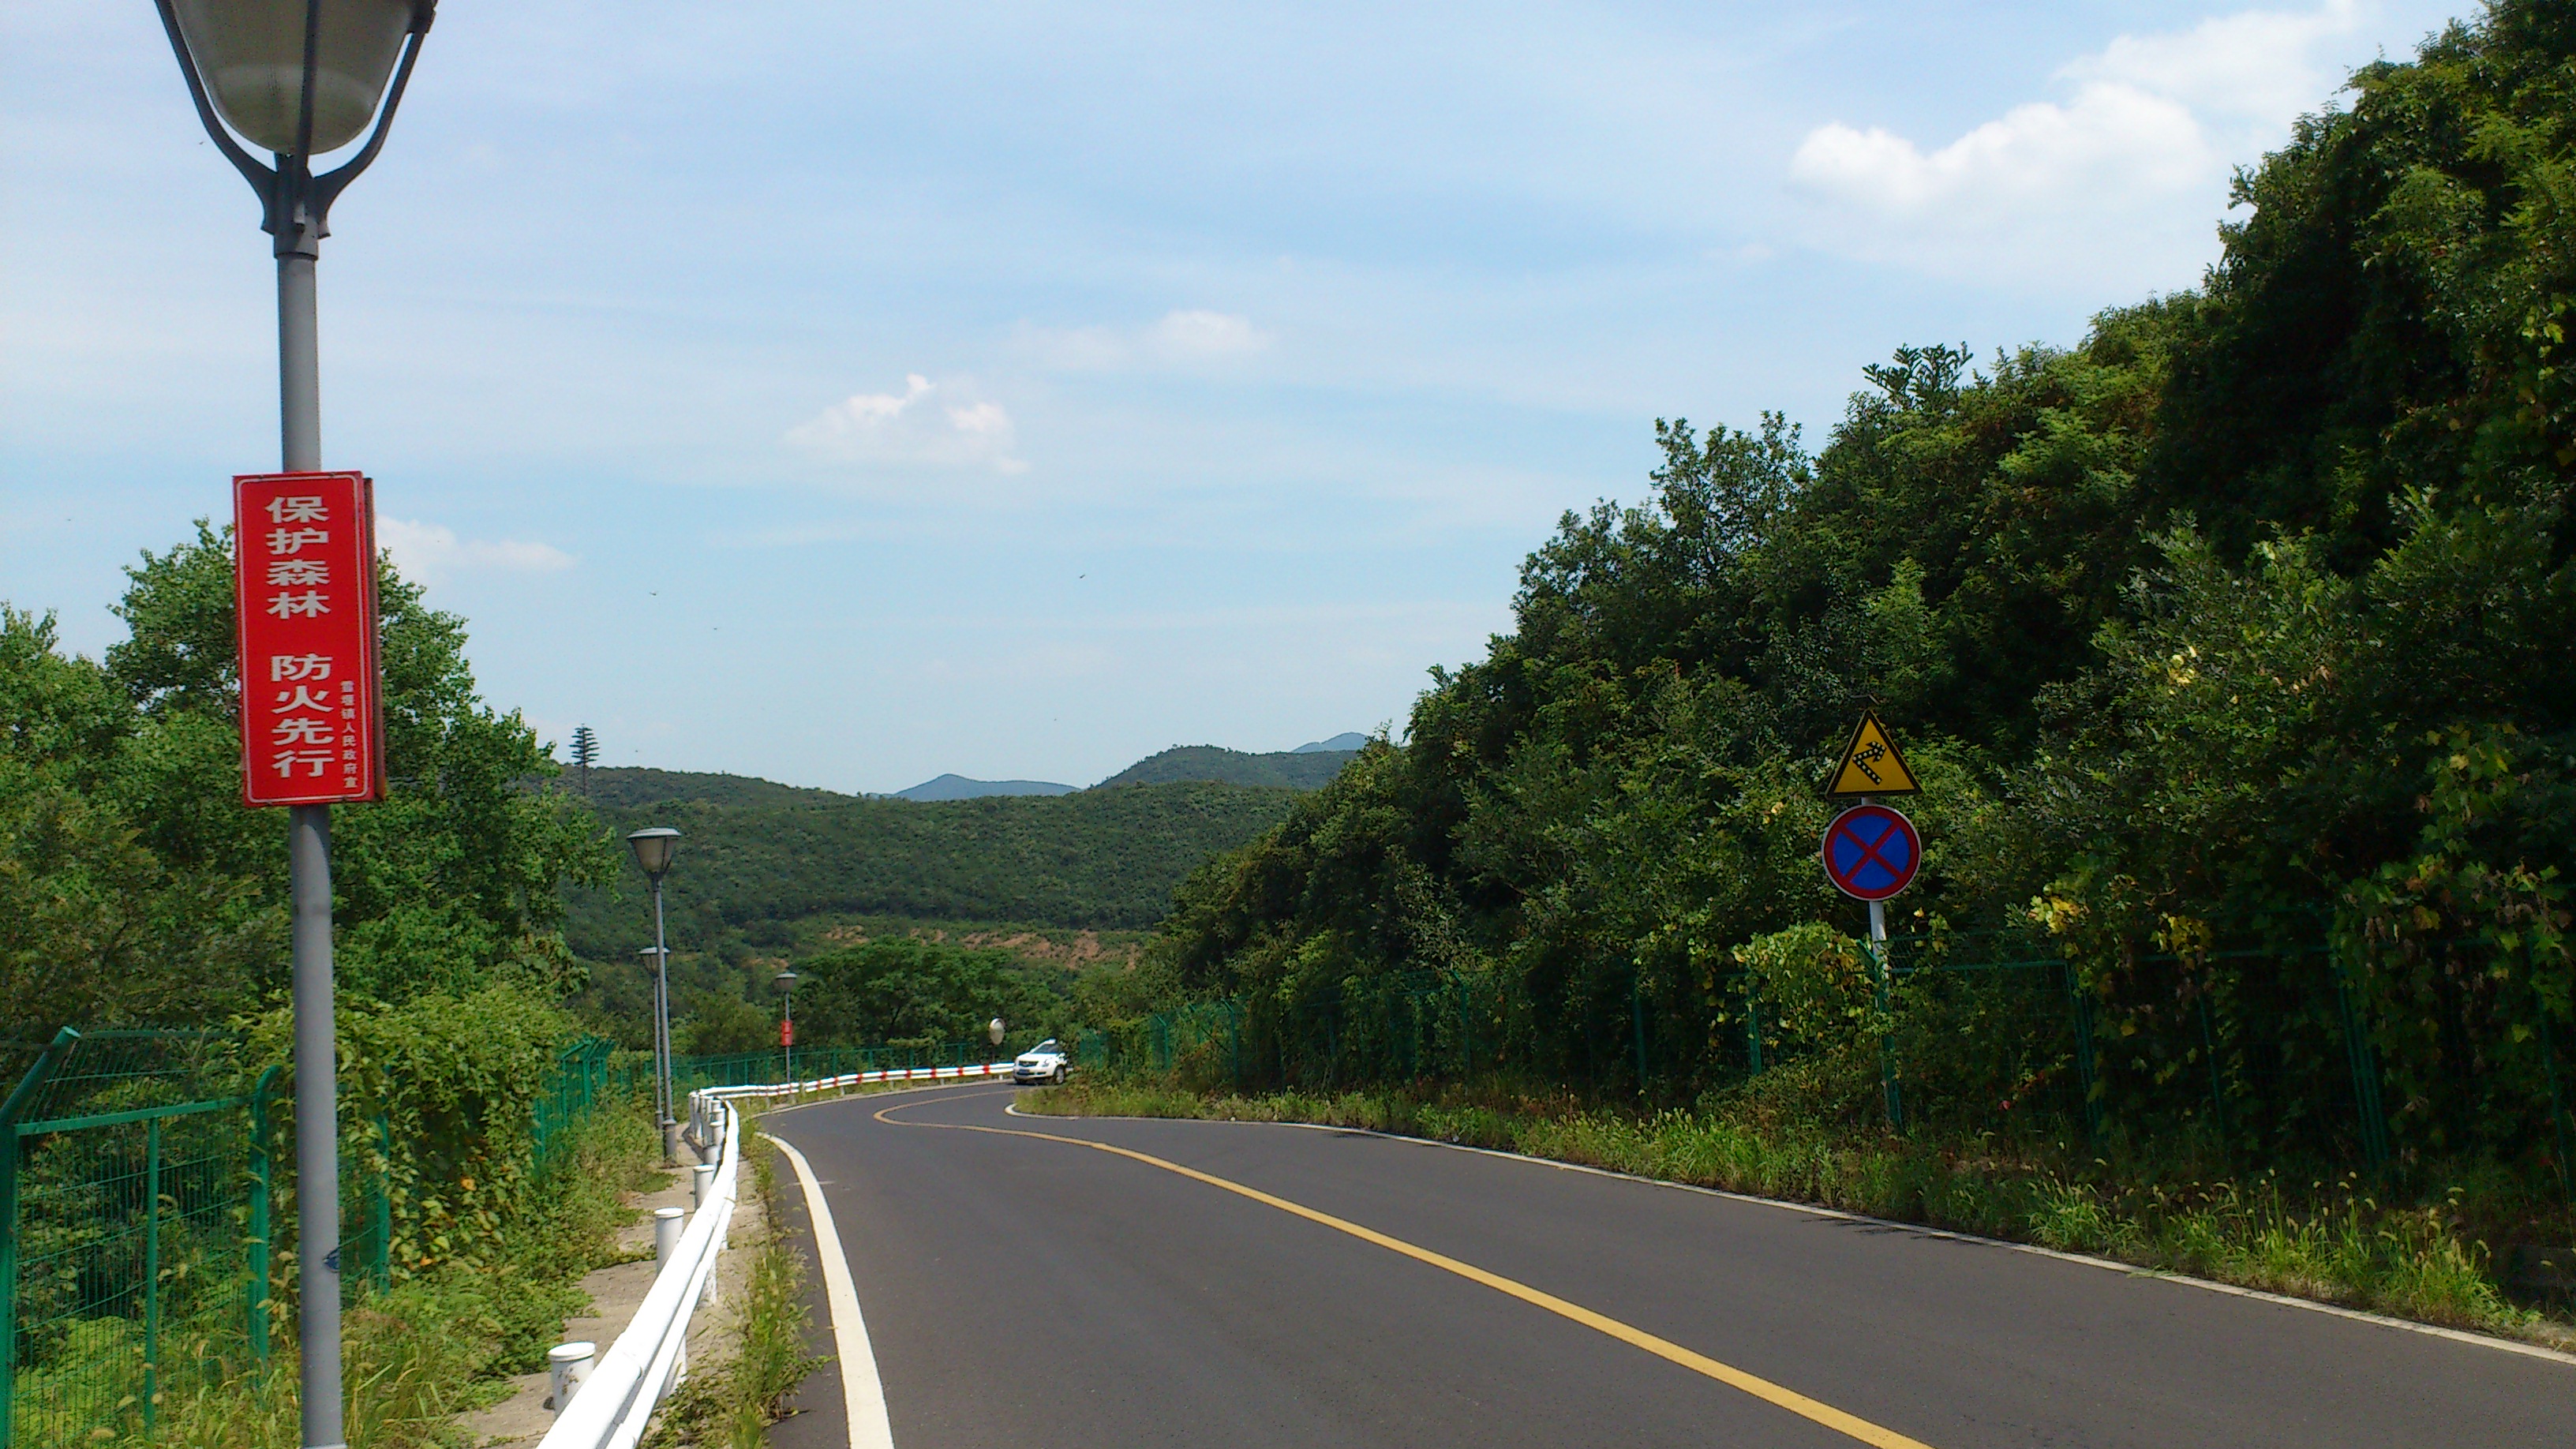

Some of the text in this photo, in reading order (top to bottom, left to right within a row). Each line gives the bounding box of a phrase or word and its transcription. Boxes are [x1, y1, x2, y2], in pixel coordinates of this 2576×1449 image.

[265, 496, 335, 777] 保护森林 防火先行
